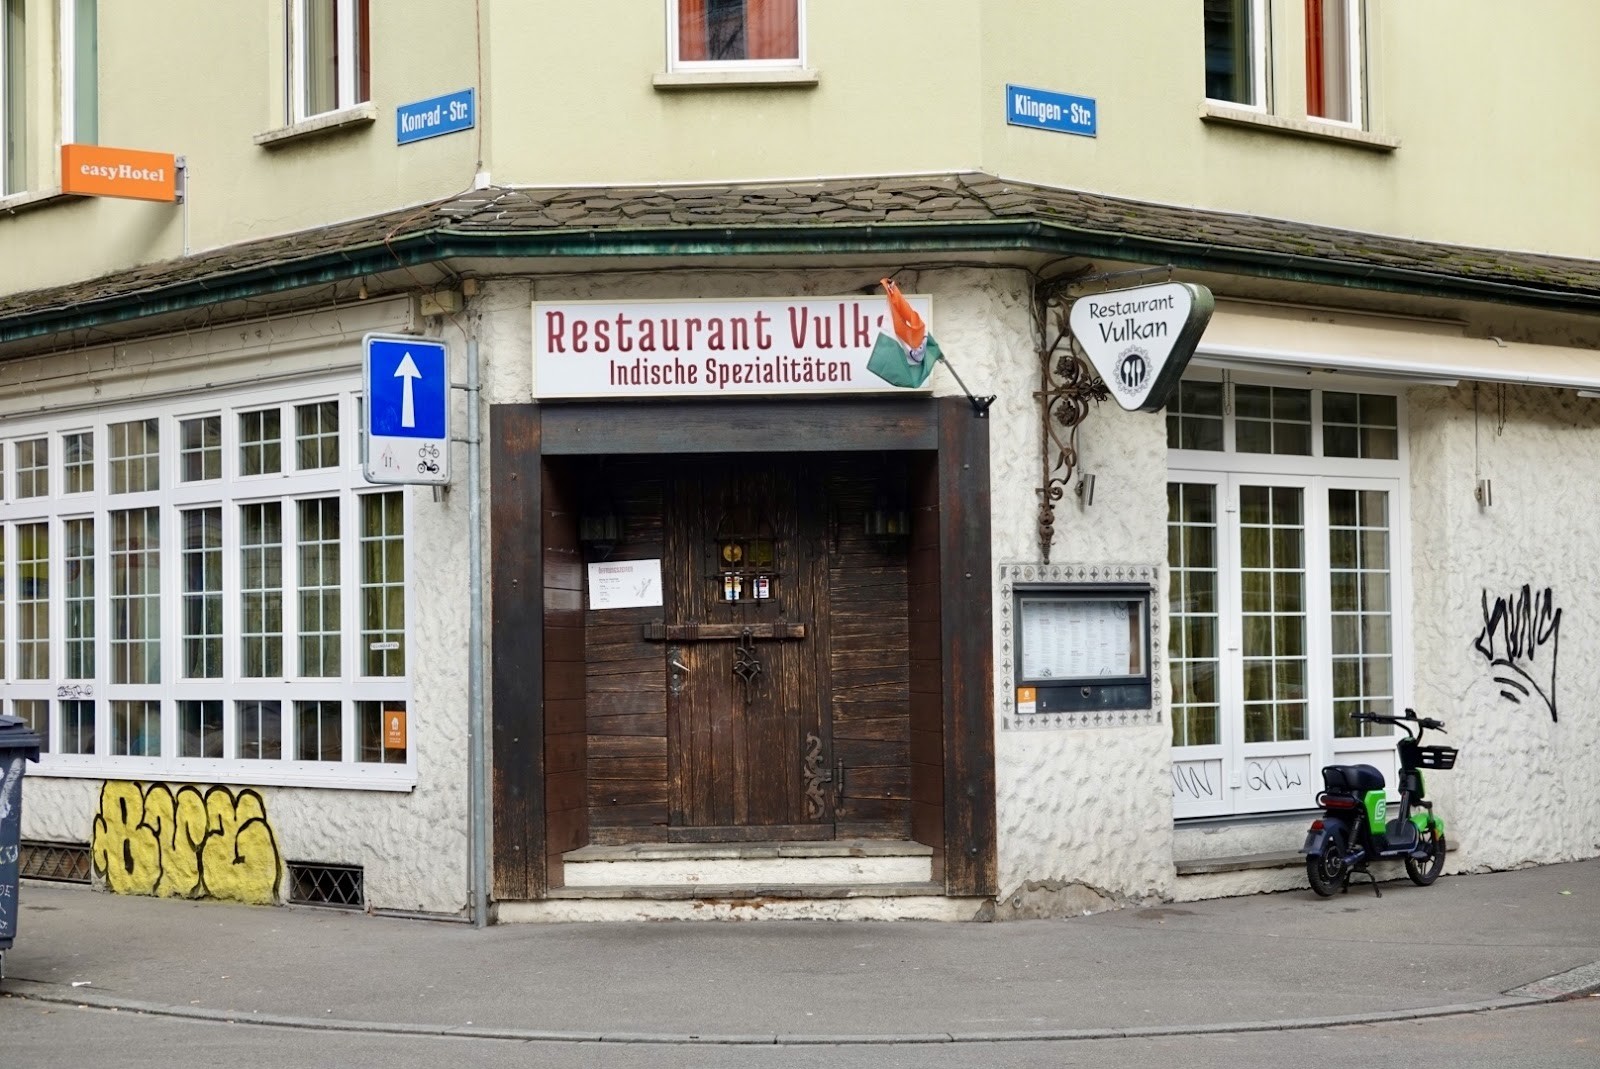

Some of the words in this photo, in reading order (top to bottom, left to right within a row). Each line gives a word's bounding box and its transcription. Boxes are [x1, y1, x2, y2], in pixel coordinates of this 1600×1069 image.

[80, 164, 165, 182] easyHotel
[1089, 294, 1174, 319] Restaurant
[546, 310, 772, 353] Restaurant
[787, 303, 884, 349] Vulk
[1098, 318, 1168, 343] Vulkan
[610, 357, 698, 386] Indische
[705, 355, 852, 390] Spezialitäten
